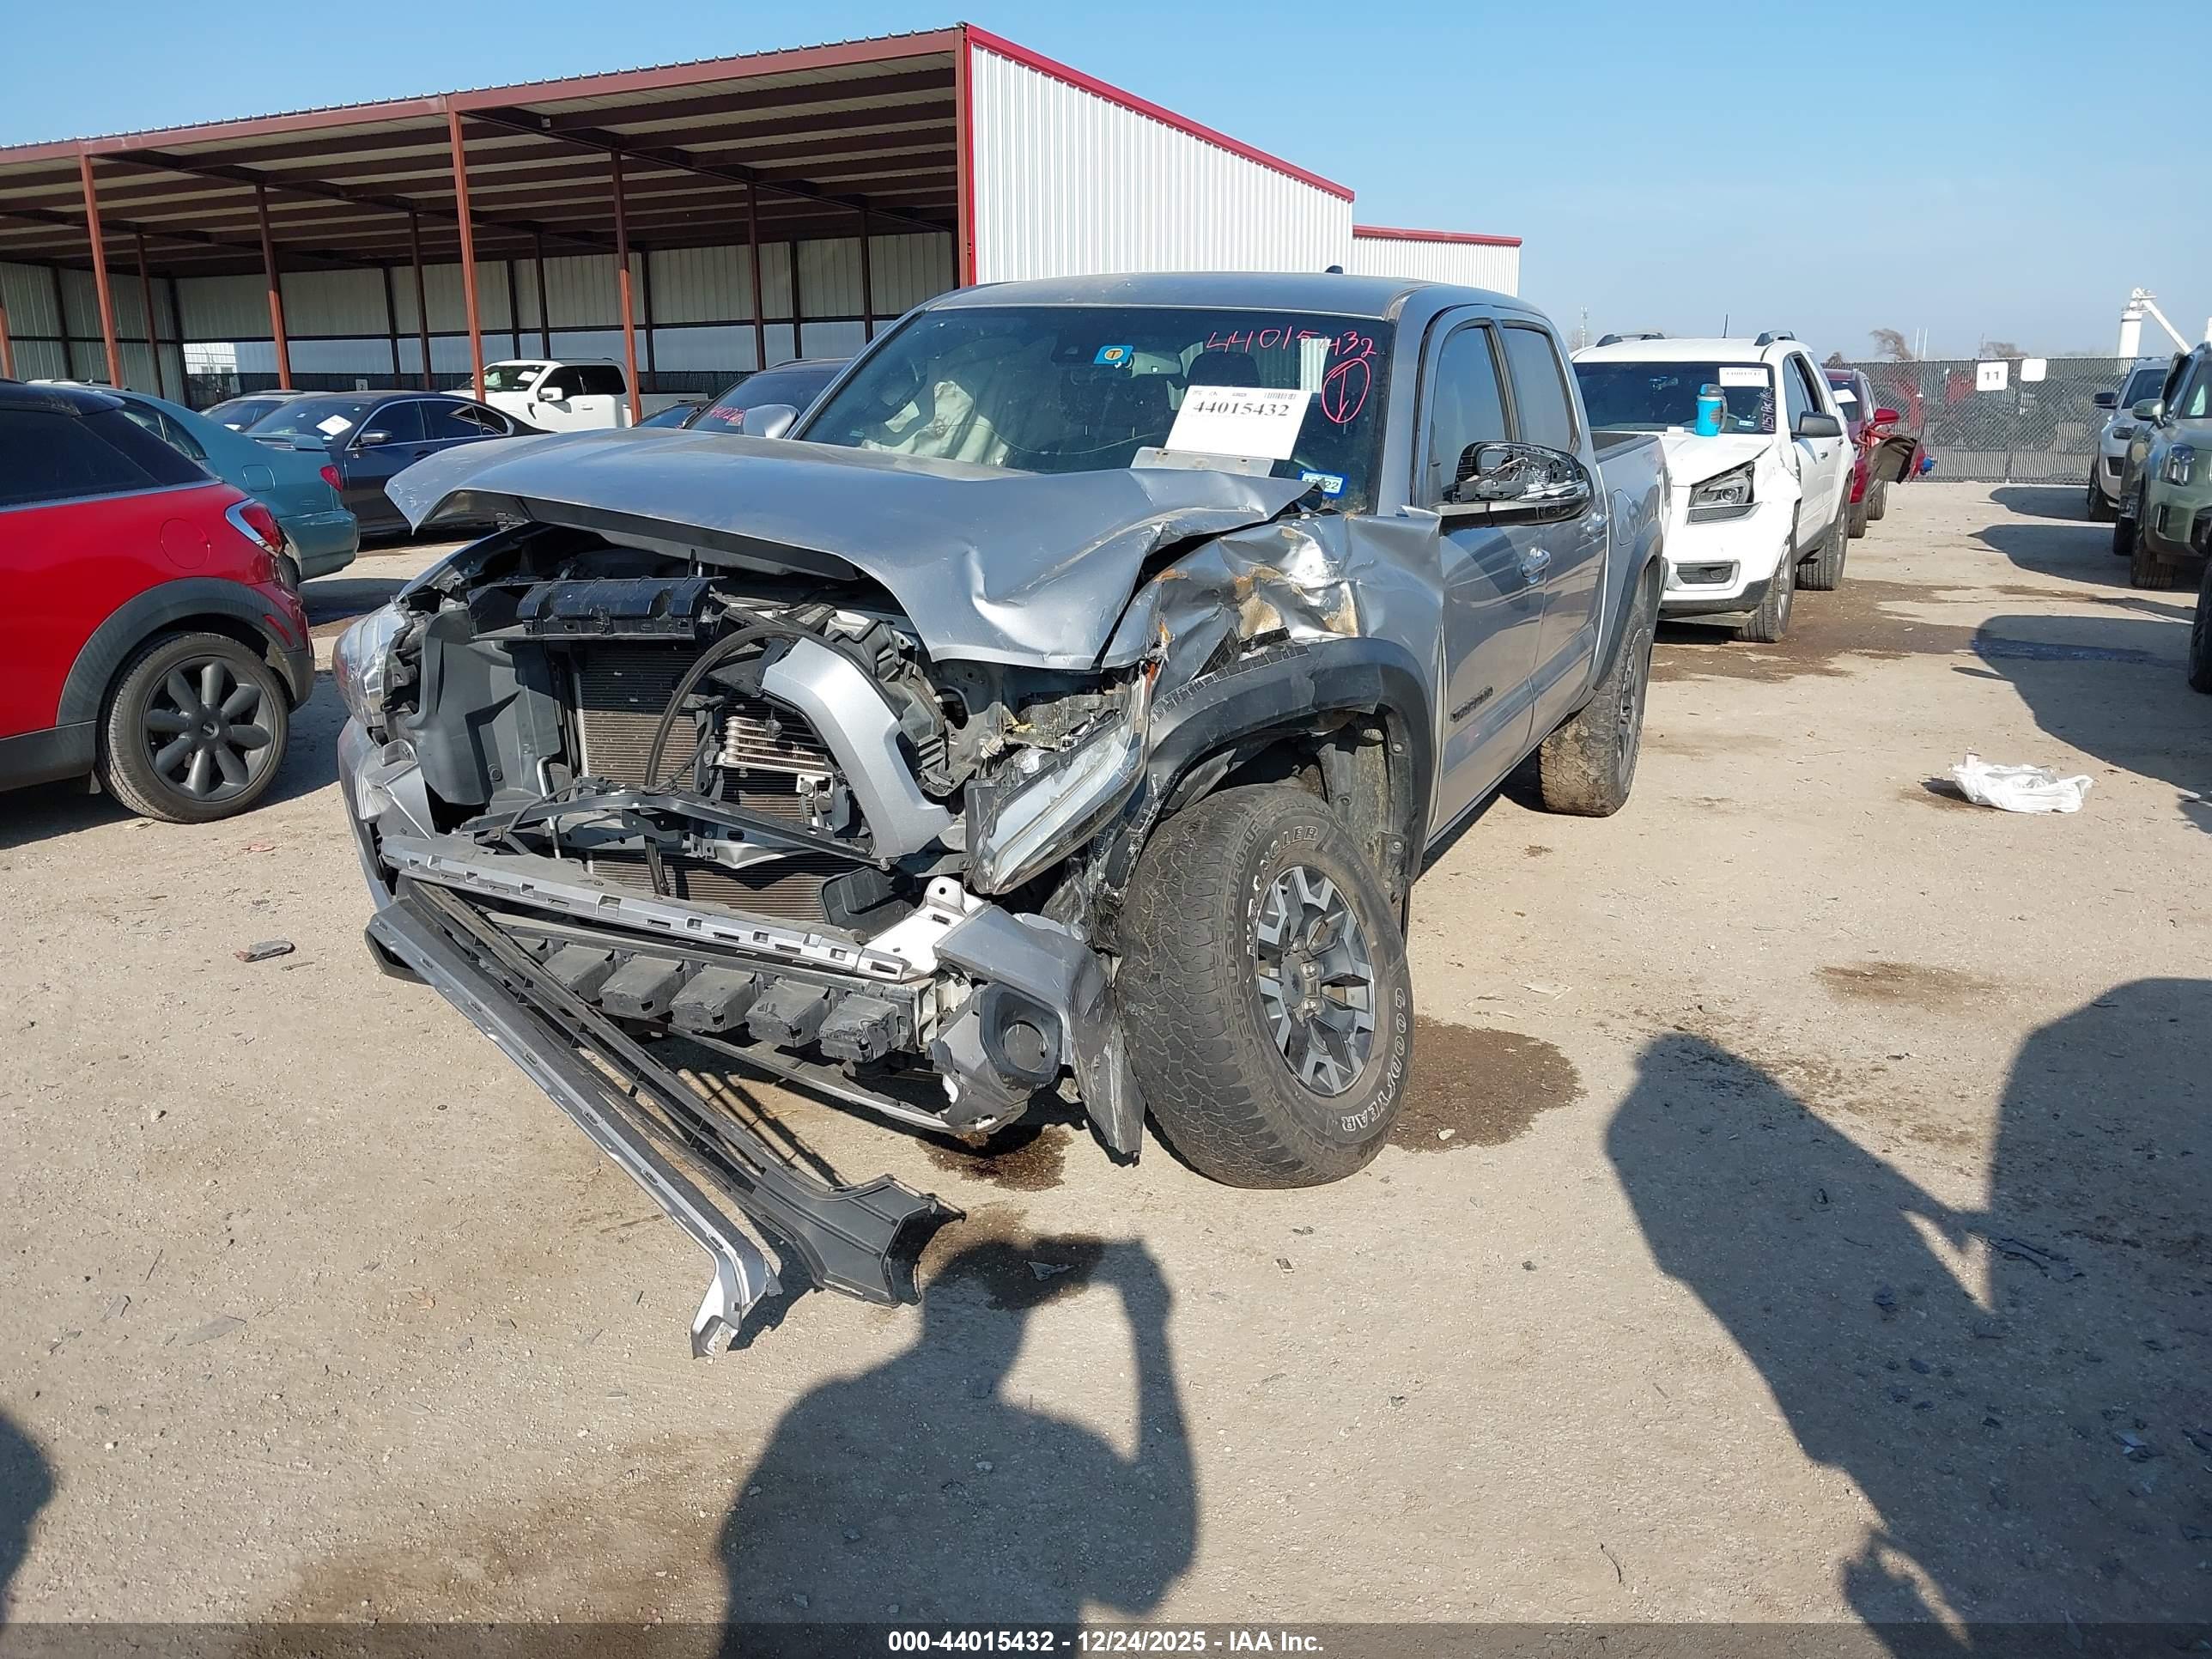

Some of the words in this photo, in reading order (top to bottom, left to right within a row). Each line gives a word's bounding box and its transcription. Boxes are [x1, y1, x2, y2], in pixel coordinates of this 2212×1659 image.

[1206, 325, 1377, 358] 44015432
[1984, 371, 1999, 380] 11
[1193, 401, 1290, 417] 44015432
[1341, 988, 1407, 1132] GOODYEAR
